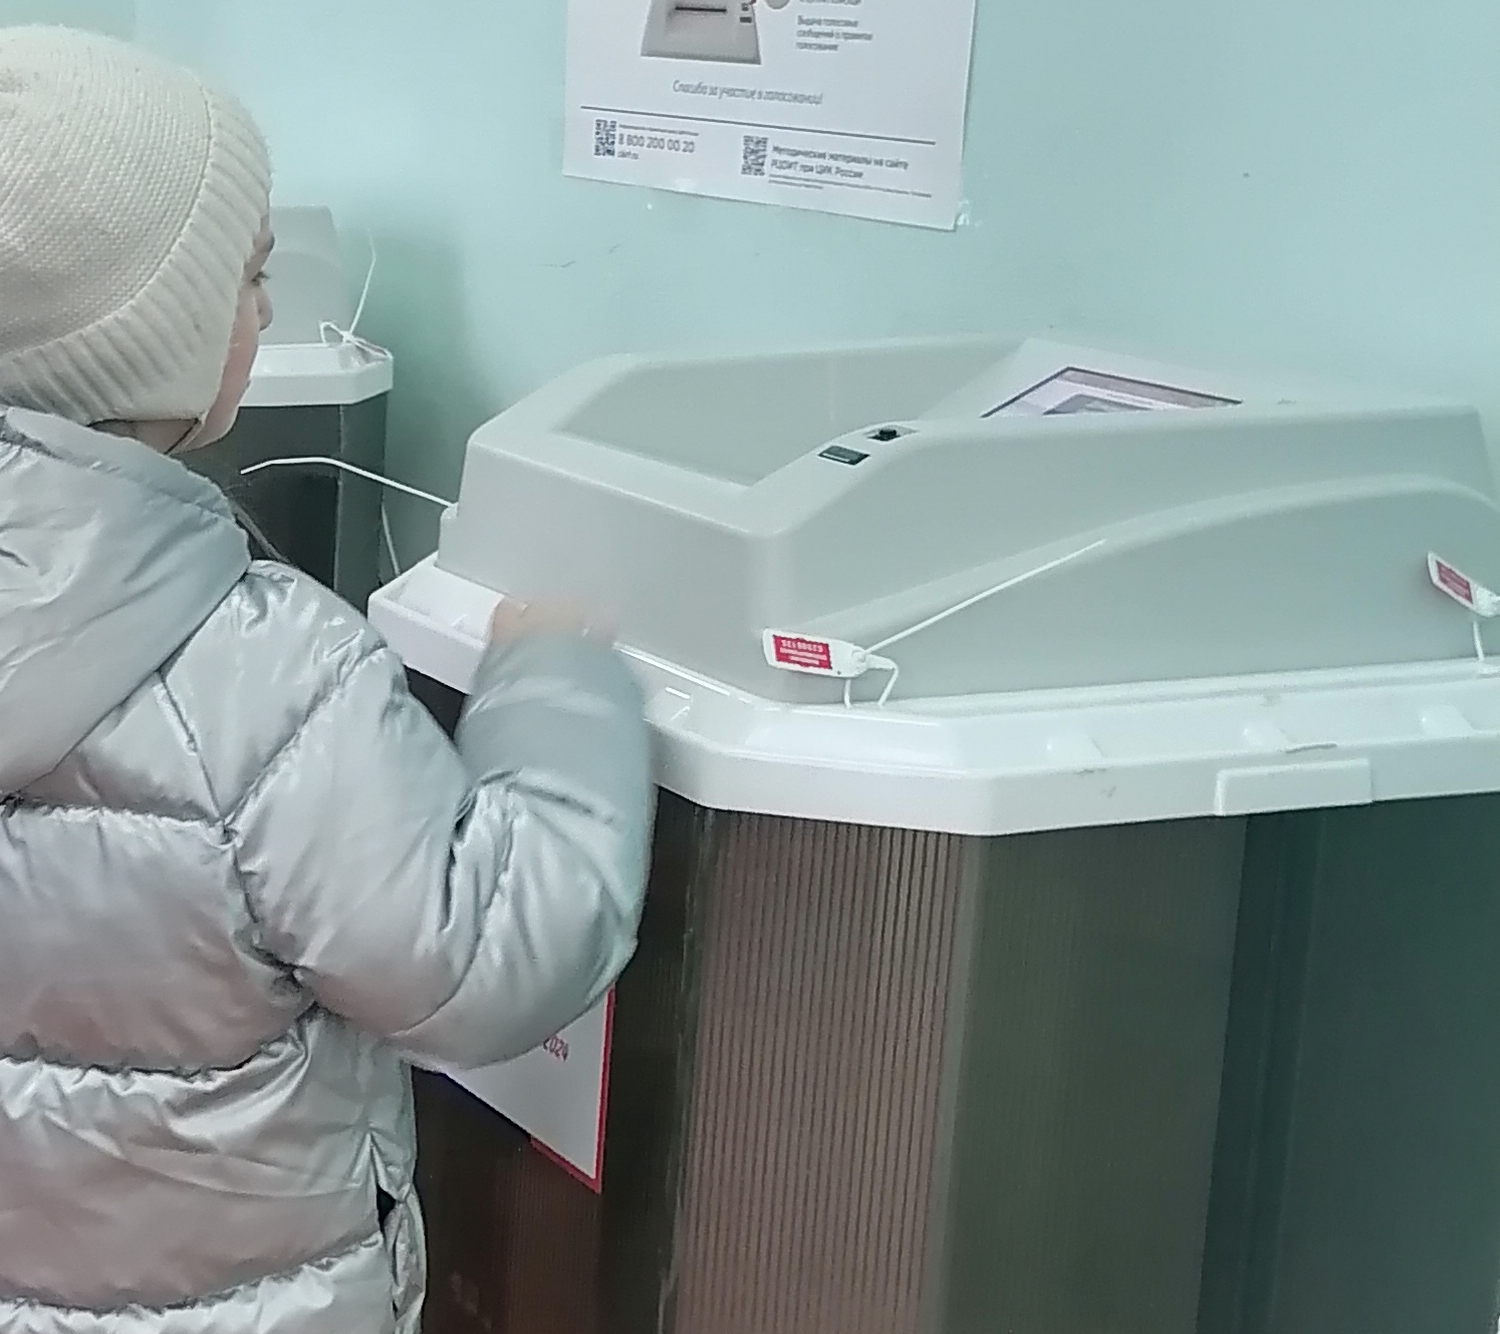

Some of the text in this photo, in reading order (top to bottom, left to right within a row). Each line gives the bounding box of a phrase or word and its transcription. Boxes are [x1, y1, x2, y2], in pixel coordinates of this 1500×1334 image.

[673, 79, 708, 95] Спасибо
[719, 87, 757, 100] участие
[626, 134, 645, 147] 800
[646, 136, 665, 150] 200
[667, 138, 680, 152] 00
[682, 140, 695, 153] 20
[828, 152, 872, 166] материалы
[885, 157, 909, 171] сайте
[834, 166, 864, 179] России
